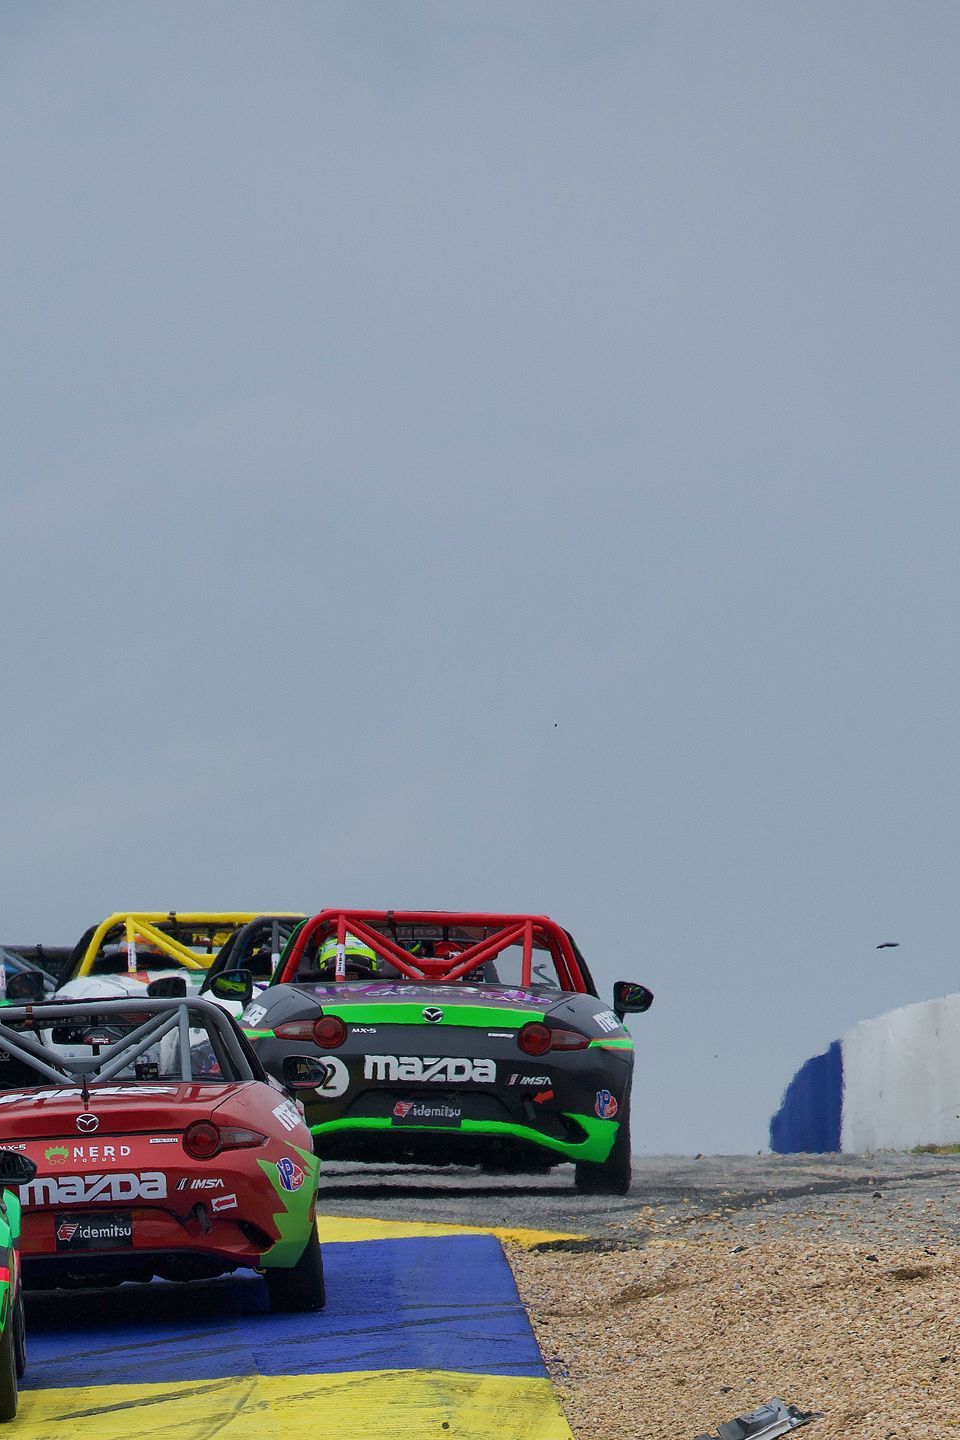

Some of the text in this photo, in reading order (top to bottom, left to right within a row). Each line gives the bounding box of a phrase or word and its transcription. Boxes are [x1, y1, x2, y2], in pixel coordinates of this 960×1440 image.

[351, 1027, 377, 1035] MX-5
[519, 1075, 553, 1086] IMSA
[413, 1103, 462, 1118] idemitsu
[73, 1144, 132, 1158] NERD
[190, 1178, 225, 1190] IMSA
[79, 1224, 132, 1239] idemitsu
